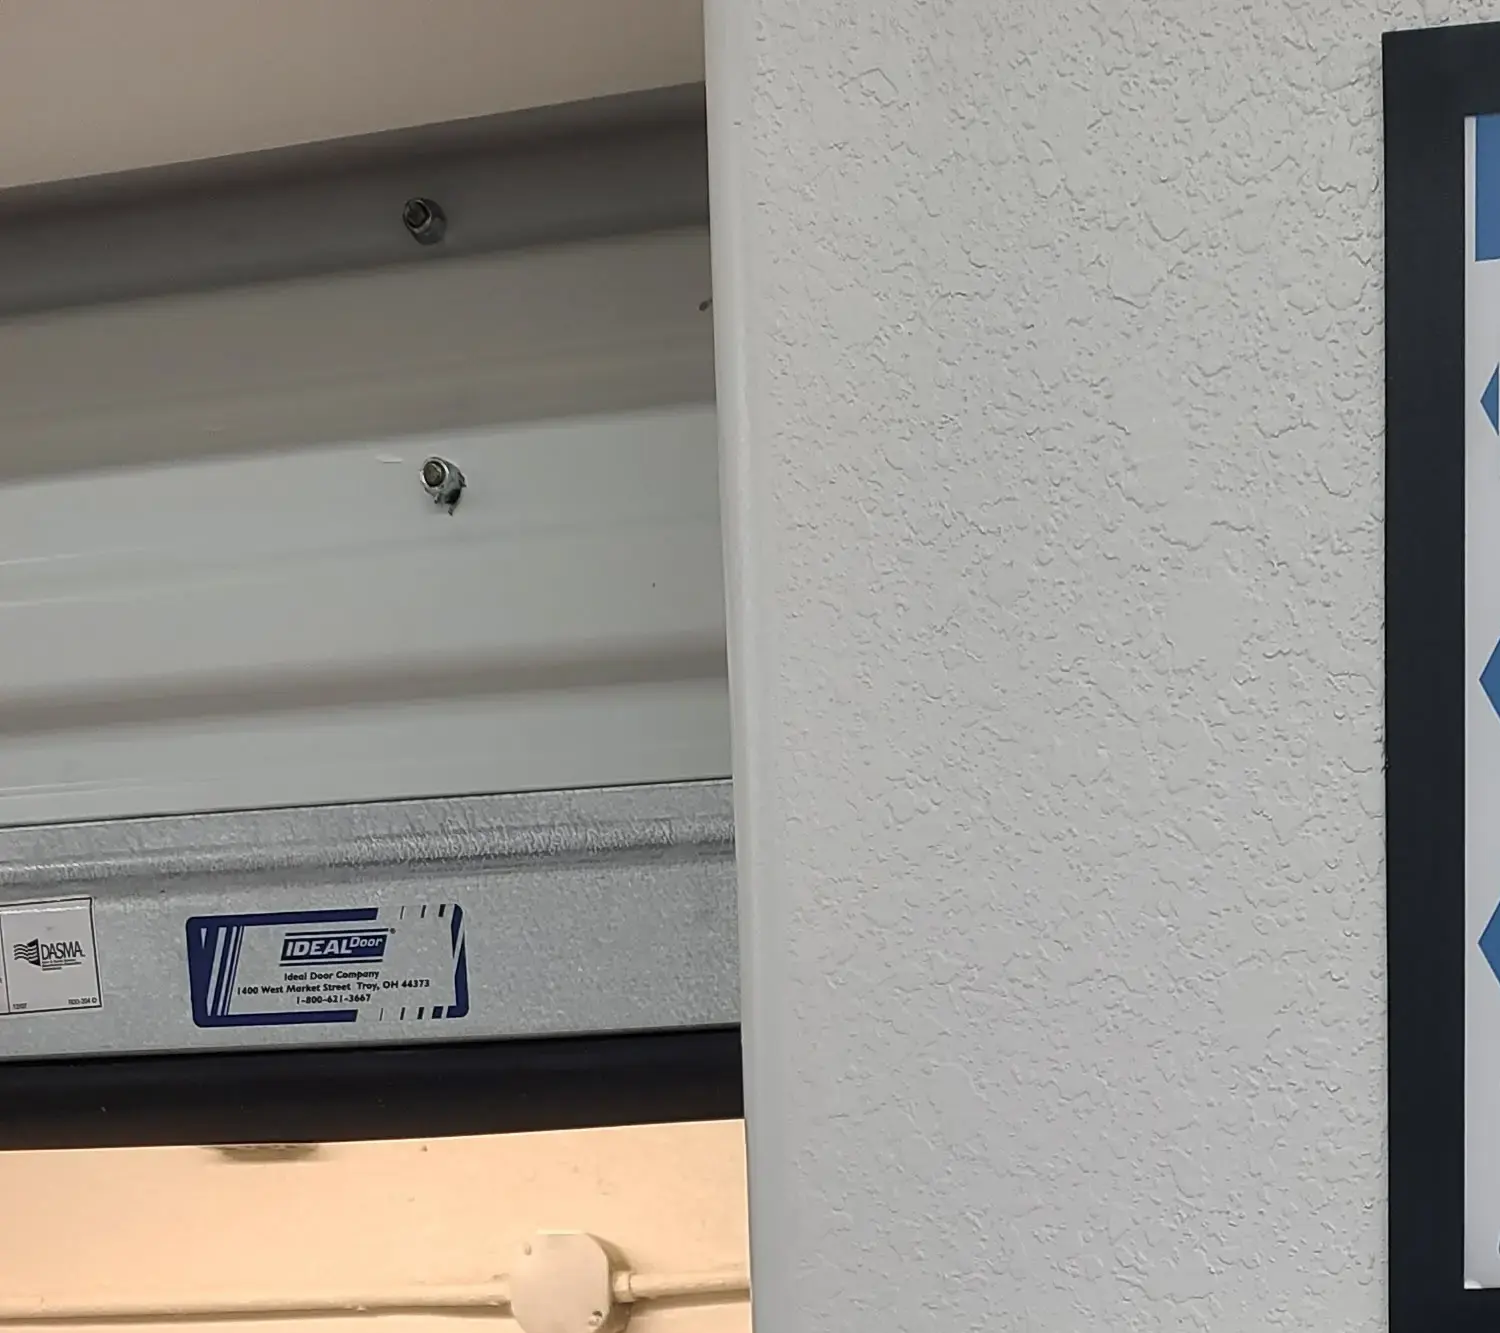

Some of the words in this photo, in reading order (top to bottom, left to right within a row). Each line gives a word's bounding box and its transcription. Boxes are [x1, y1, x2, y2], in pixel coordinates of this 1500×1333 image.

[41, 941, 85, 960] DASMA
[284, 972, 308, 981] Ideal
[310, 971, 334, 980] Door
[336, 969, 379, 980] Company
[237, 985, 259, 995] 1400
[261, 985, 284, 994] West
[286, 983, 321, 993] Market
[323, 982, 351, 991] Street
[357, 981, 380, 991] Troy,
[382, 980, 399, 989] OH
[401, 979, 430, 988] 44373
[296, 994, 372, 1005] 1-800-621-3667
